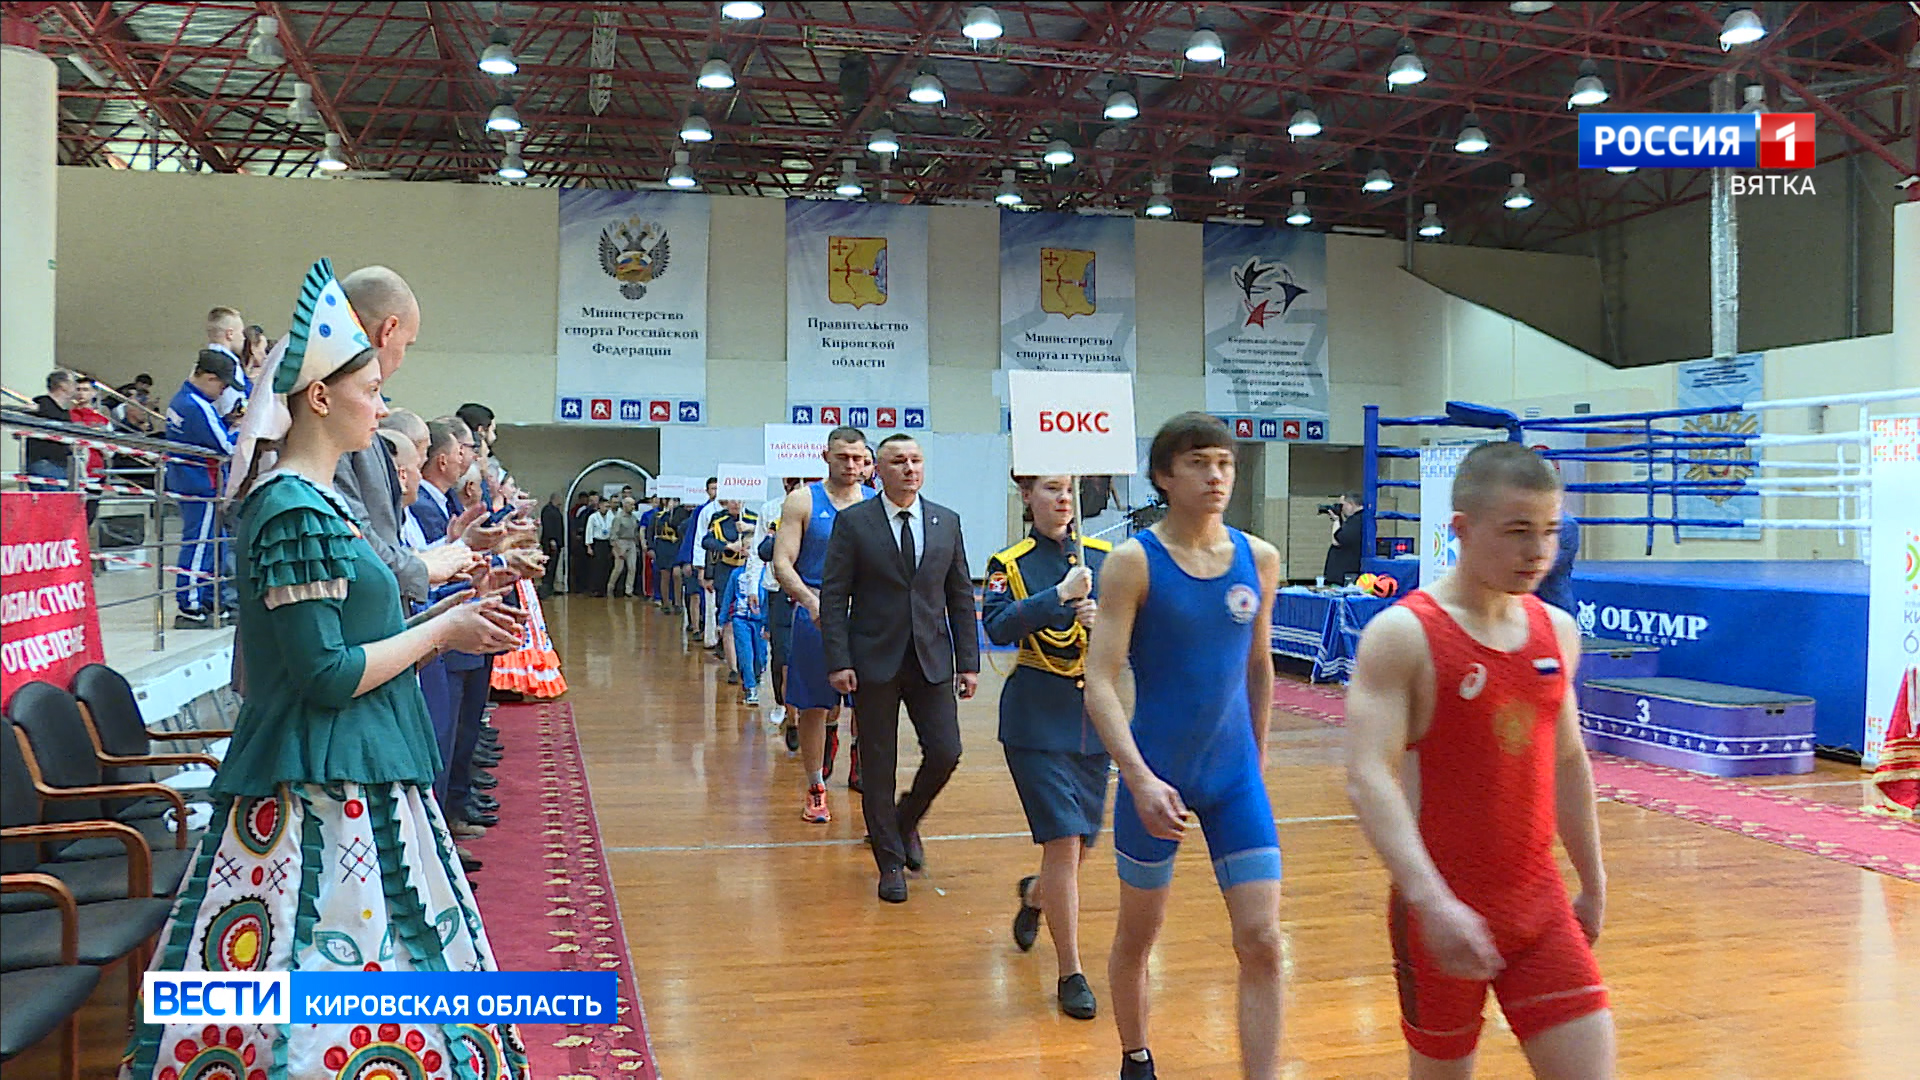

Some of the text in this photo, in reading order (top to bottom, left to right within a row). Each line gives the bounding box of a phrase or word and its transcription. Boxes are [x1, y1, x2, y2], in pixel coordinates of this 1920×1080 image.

[582, 307, 684, 321] Министерство
[808, 317, 908, 331] Правительство
[565, 325, 699, 339] спорта Российской
[822, 337, 895, 349] Кировской
[1025, 333, 1113, 347] Министерство
[593, 343, 671, 357] Федерации
[1016, 351, 1058, 361] спорта
[1071, 353, 1121, 363] туризма
[832, 357, 885, 367] области
[1039, 411, 1110, 433] БОКС
[770, 442, 809, 450] ТАЙСКИЙ
[723, 477, 761, 487] ДЗЮДО
[1600, 605, 1709, 640] OLYMP
[1635, 699, 1650, 723] 3
